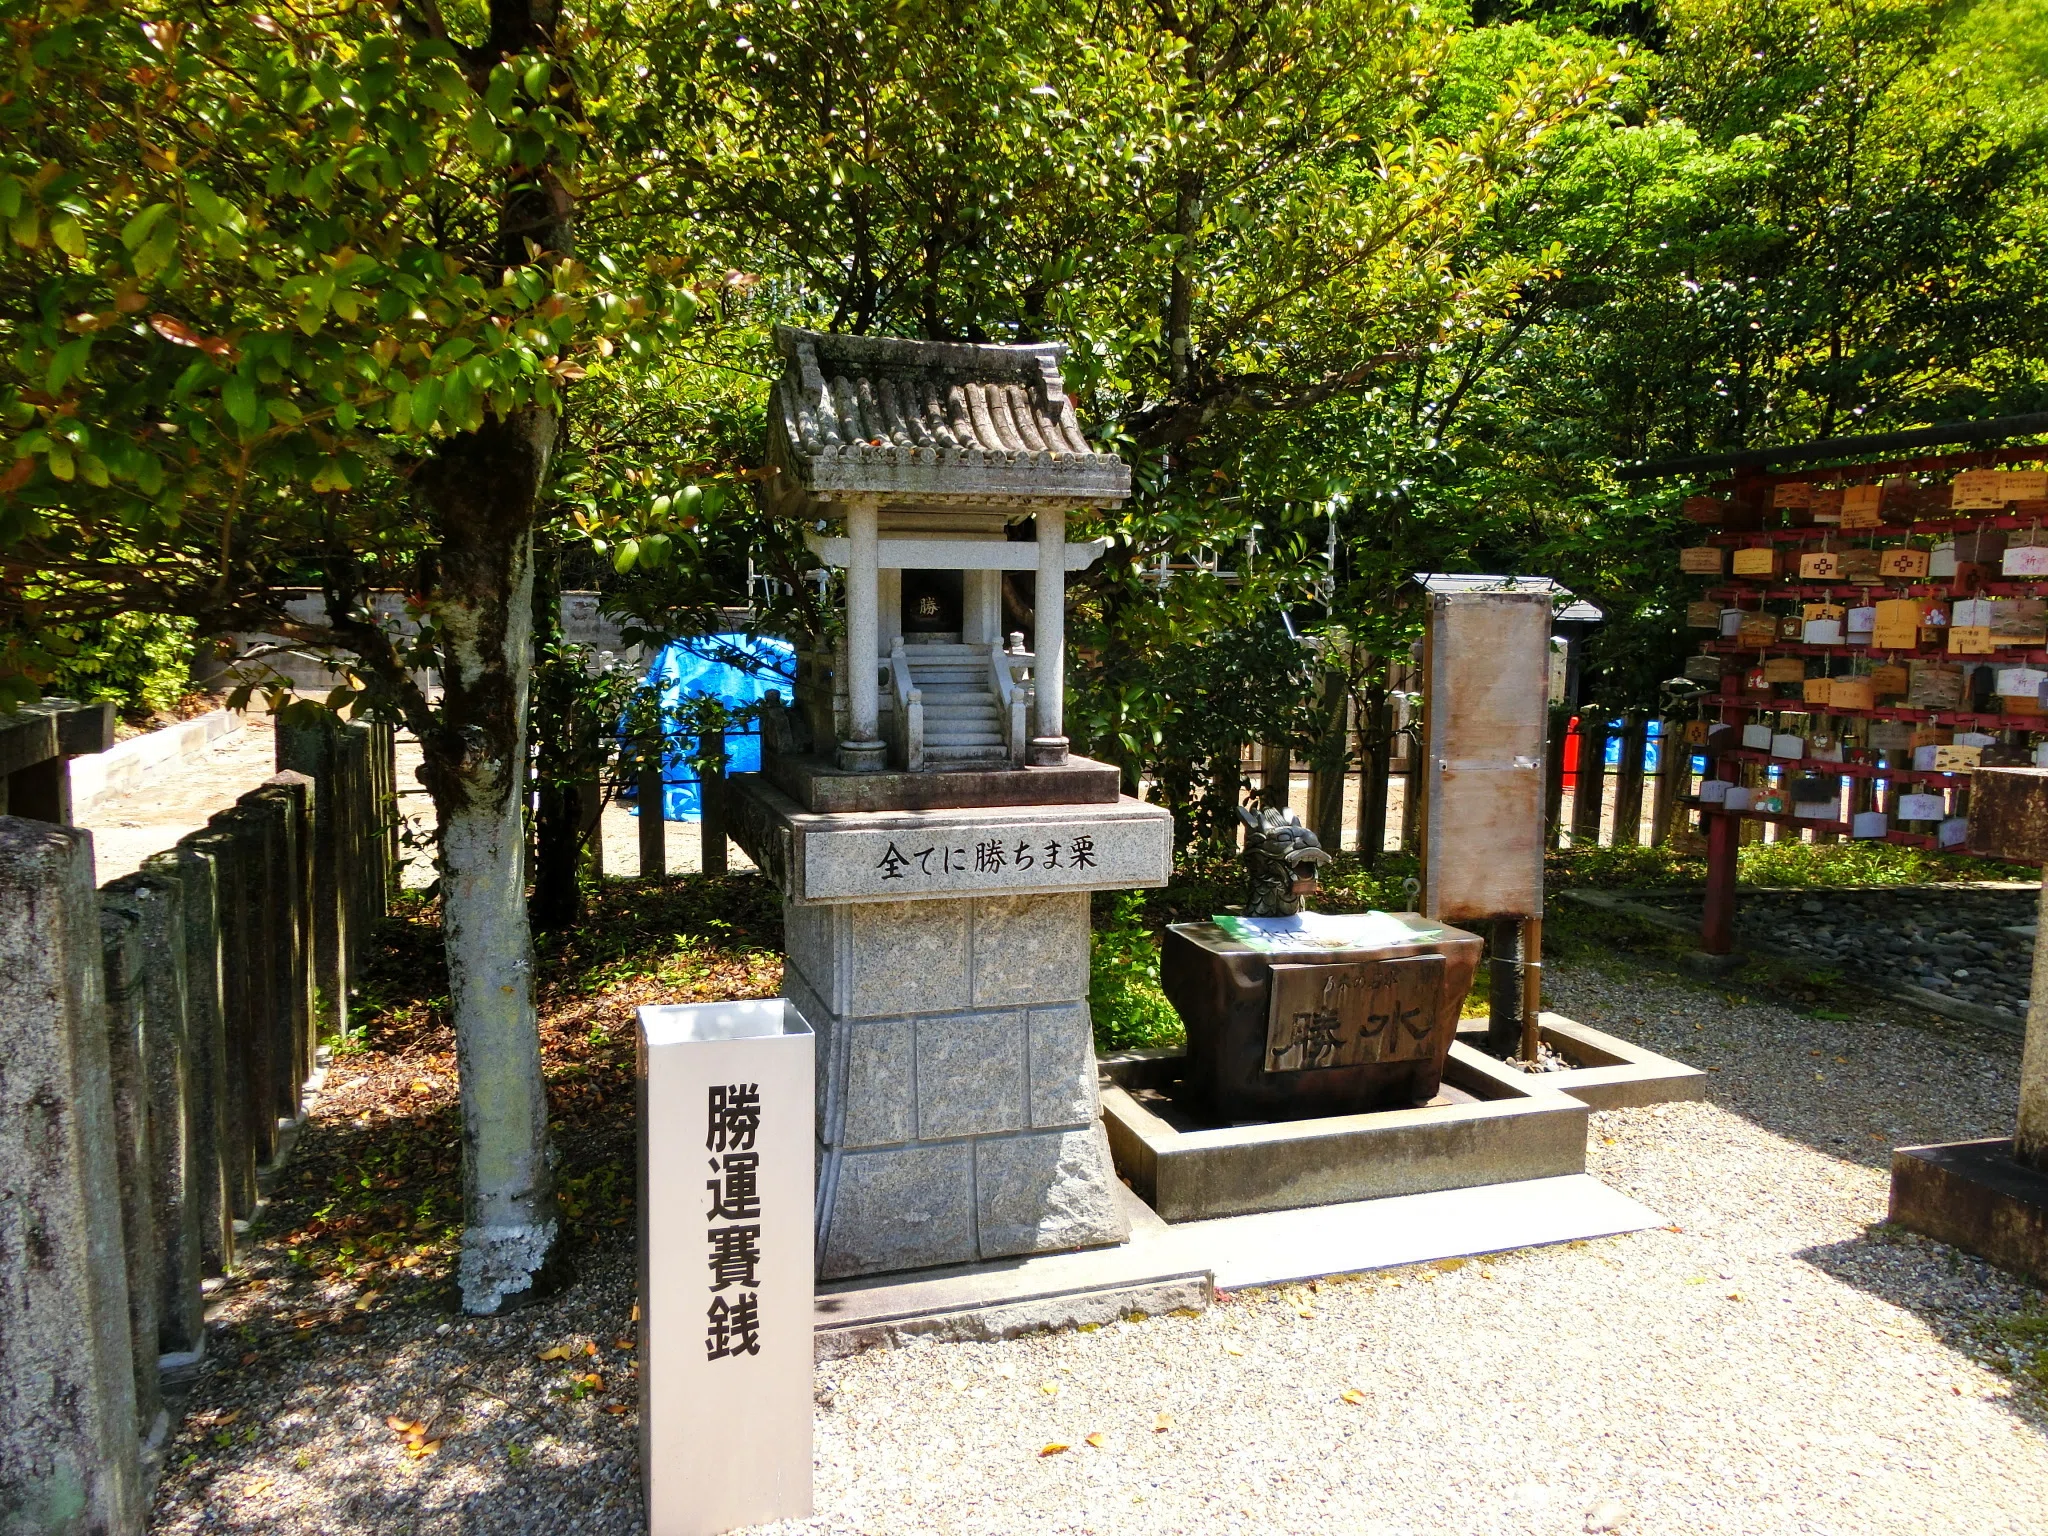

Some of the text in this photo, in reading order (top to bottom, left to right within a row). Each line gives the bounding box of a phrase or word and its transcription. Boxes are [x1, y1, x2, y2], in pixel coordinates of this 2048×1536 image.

[919, 596, 940, 615] 勝
[876, 835, 1098, 880] 全てに勝ちま栗
[1272, 1001, 1433, 1060] 勝水
[705, 1083, 761, 1361] 勝運賽銭
